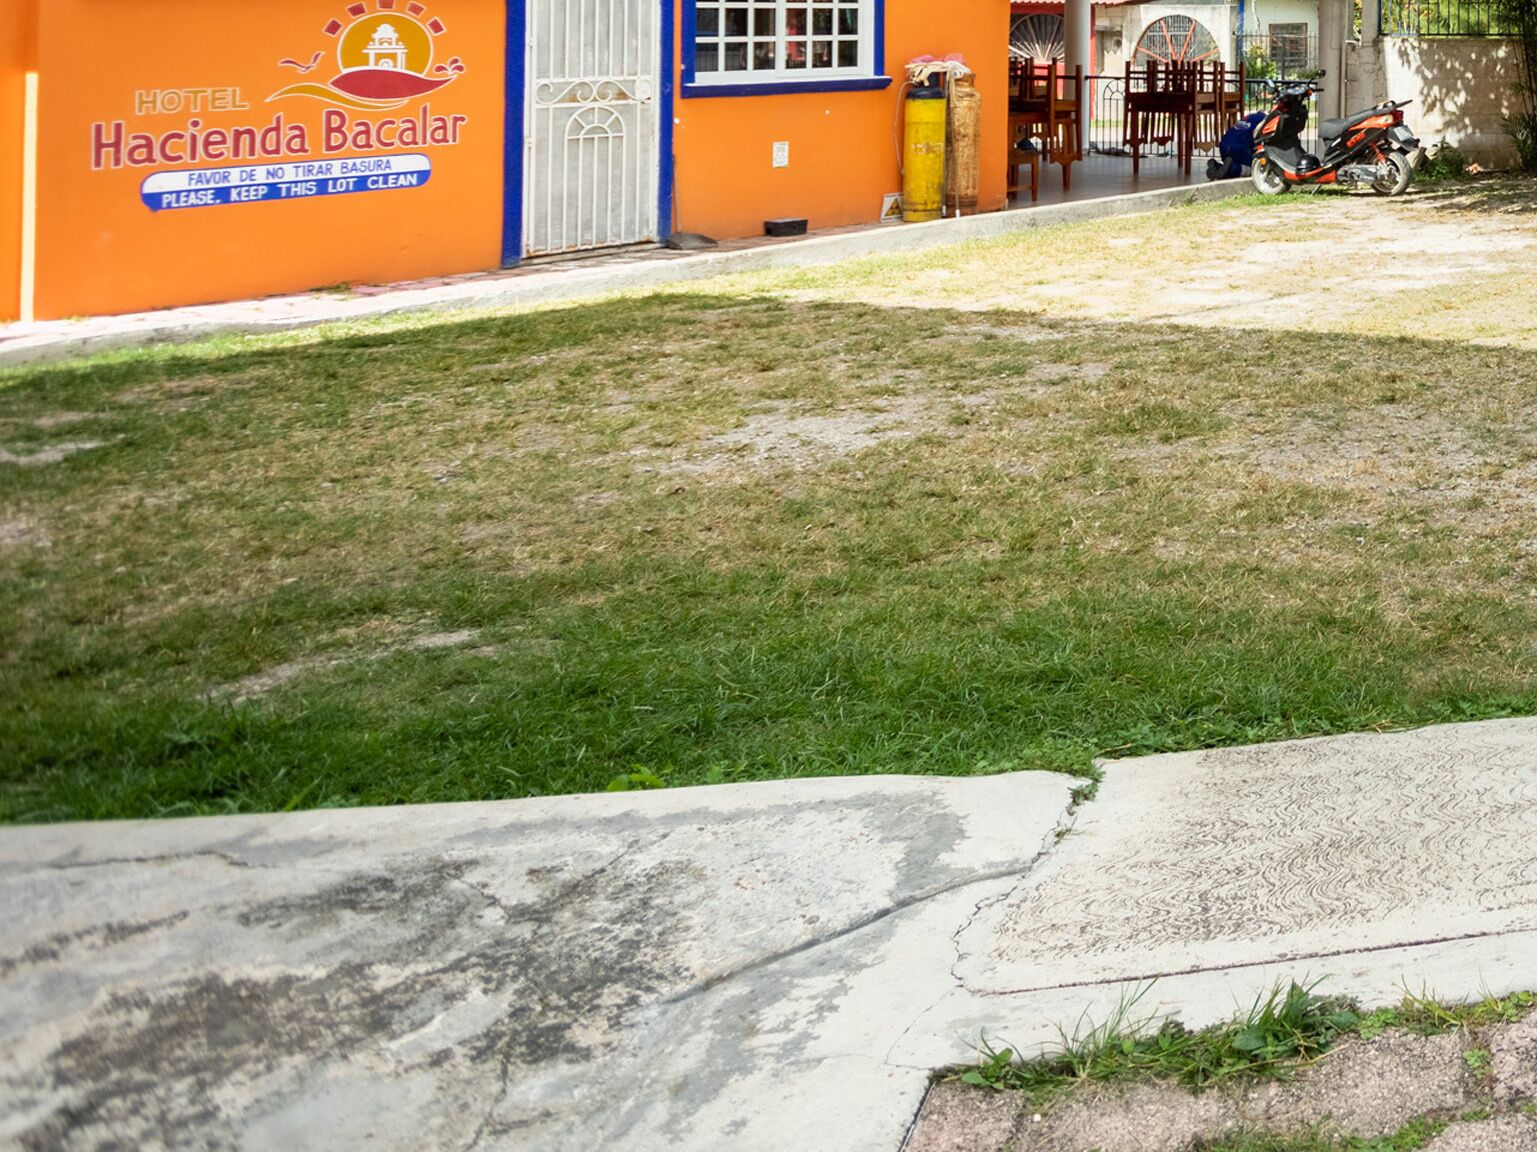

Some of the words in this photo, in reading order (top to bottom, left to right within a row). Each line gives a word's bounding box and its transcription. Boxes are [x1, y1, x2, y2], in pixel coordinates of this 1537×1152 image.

[135, 88, 249, 115] HOTEL
[91, 112, 309, 170] Hacienda
[323, 102, 467, 154] Bacalar
[188, 170, 231, 187] FAVOR
[239, 168, 257, 182] DE
[266, 166, 285, 181] NO
[293, 162, 333, 178] TIRAR
[340, 159, 392, 175] BASURA
[230, 185, 268, 202] KEEP
[277, 181, 317, 197] THIS
[328, 177, 358, 193] LOT
[367, 173, 419, 189] CLEAN
